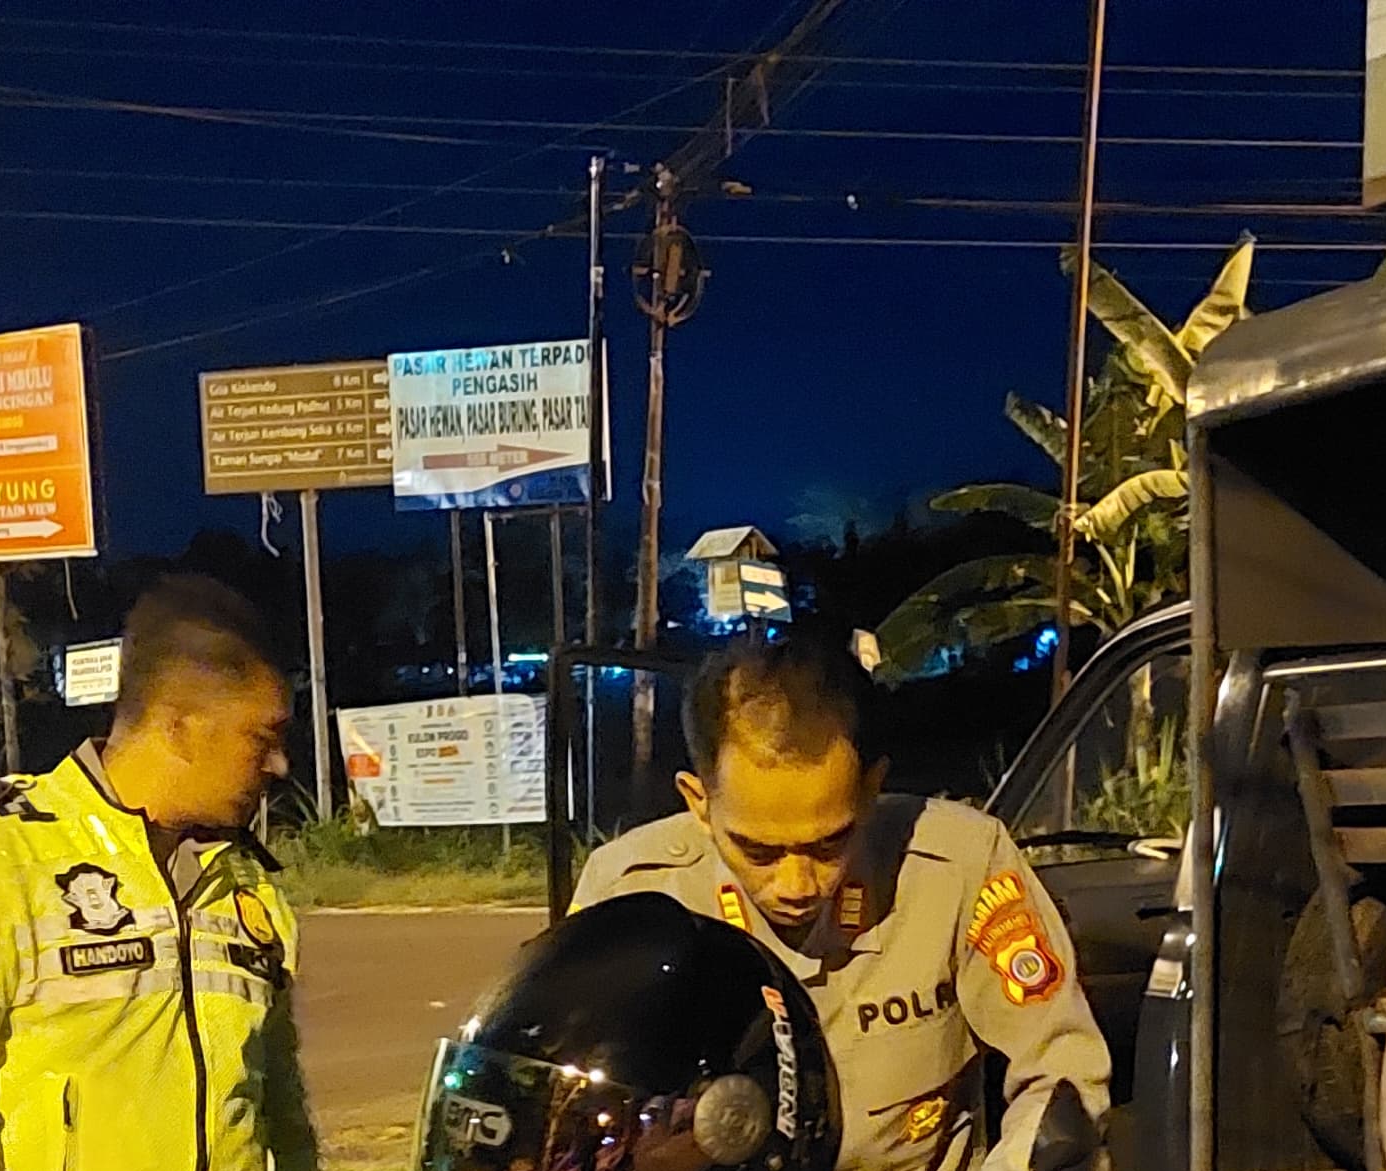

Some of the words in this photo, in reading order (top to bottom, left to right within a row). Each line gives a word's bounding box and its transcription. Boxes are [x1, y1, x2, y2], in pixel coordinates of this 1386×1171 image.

[394, 353, 446, 376] PASAR
[452, 349, 513, 372] HEWAN
[343, 375, 361, 386] Km
[452, 372, 538, 397] PENGASIH
[345, 398, 363, 410] Km
[467, 400, 497, 438] PASAR
[542, 395, 572, 432] PASAR
[346, 423, 364, 434] Km
[347, 448, 364, 459] Km
[73, 941, 144, 968] HANDOYO
